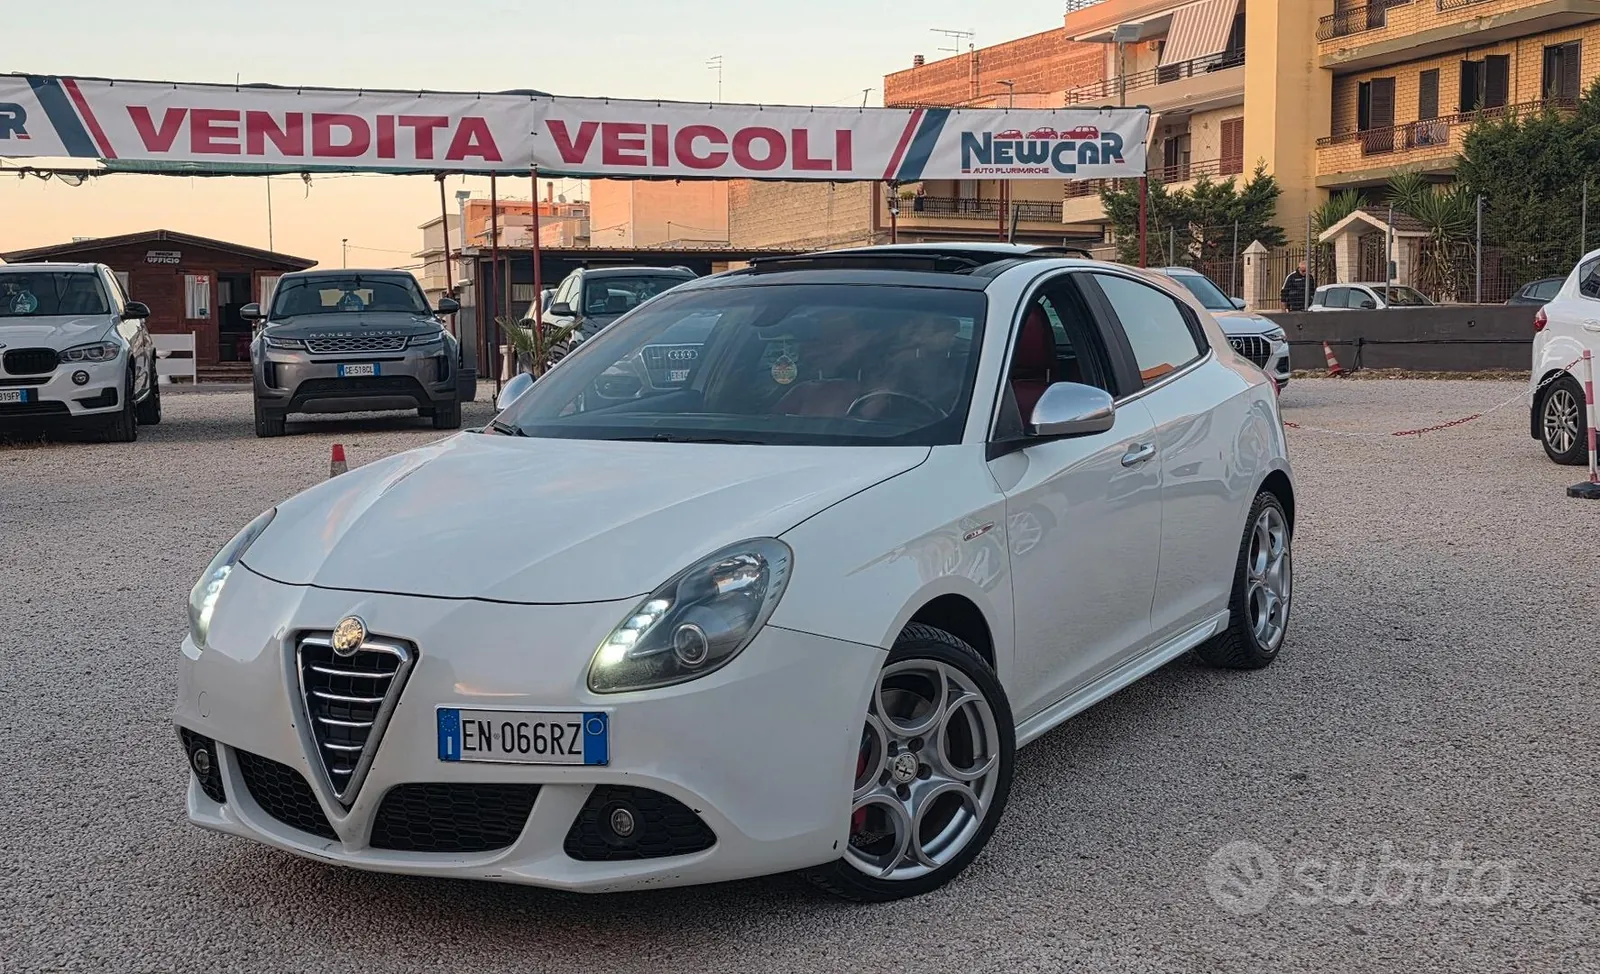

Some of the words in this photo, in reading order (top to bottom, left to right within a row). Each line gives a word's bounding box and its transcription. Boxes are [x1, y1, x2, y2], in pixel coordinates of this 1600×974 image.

[126, 105, 503, 162] VENDITA
[545, 119, 852, 171] VEICOLI
[462, 720, 492, 752] EN
[501, 721, 582, 755] 066RZ
